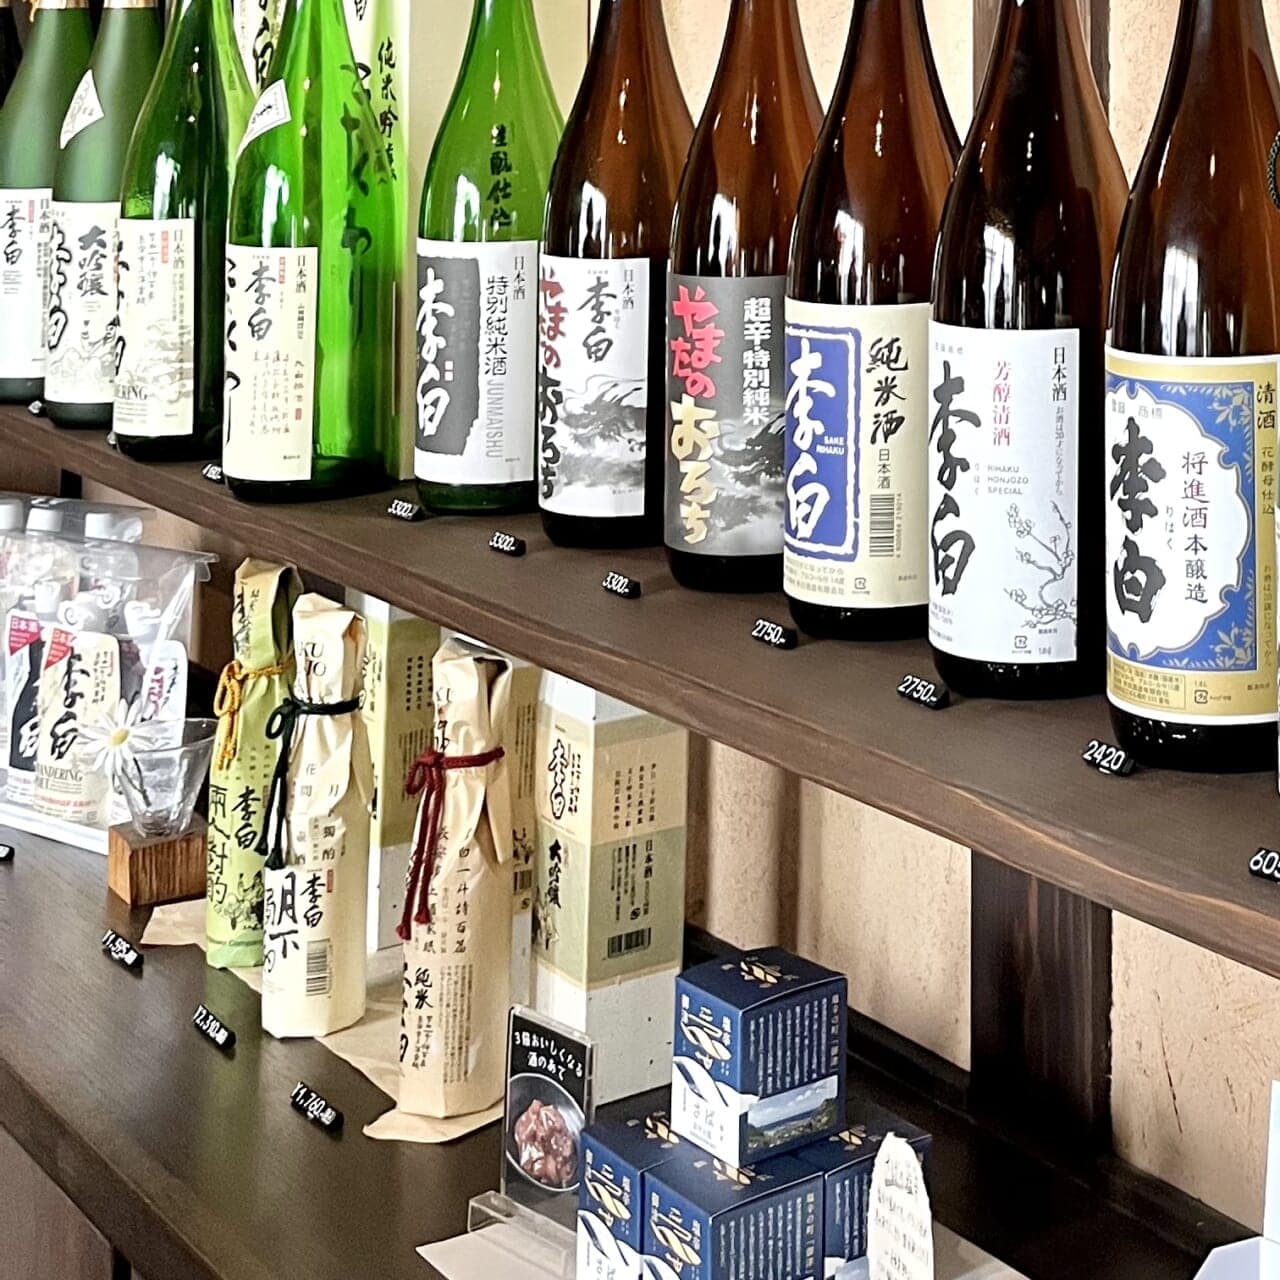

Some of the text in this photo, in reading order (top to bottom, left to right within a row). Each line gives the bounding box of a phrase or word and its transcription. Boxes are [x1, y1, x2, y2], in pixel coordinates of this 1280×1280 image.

[1, 204, 26, 266] 李白
[245, 260, 276, 341] 李白
[296, 254, 307, 294] 日本酒
[513, 256, 526, 300] 日本酒
[622, 268, 635, 310] 日本酒
[485, 275, 509, 376] 特別純米酒
[577, 276, 618, 363] 李白
[416, 267, 455, 437] 李白
[1050, 345, 1068, 403] 日本酒
[485, 379, 504, 459] JUNMAISHU
[866, 336, 909, 446] 純米酒
[1256, 382, 1277, 431] 清酒
[785, 337, 836, 540] 李白
[815, 445, 845, 456] RIHAKU
[823, 434, 845, 446] SAKE
[876, 448, 892, 490] 日本酒
[928, 360, 982, 598] 李白
[987, 475, 1029, 485] HONJOZO
[987, 486, 1024, 496] SPECIAL
[1261, 446, 1276, 516] 花酵母仕込
[1109, 417, 1168, 624] 李白
[1164, 504, 1175, 551] りはく
[1082, 740, 1126, 771] 2420
[232, 785, 261, 850] 李白
[300, 873, 327, 929] 李白
[413, 966, 434, 1010] 純米
